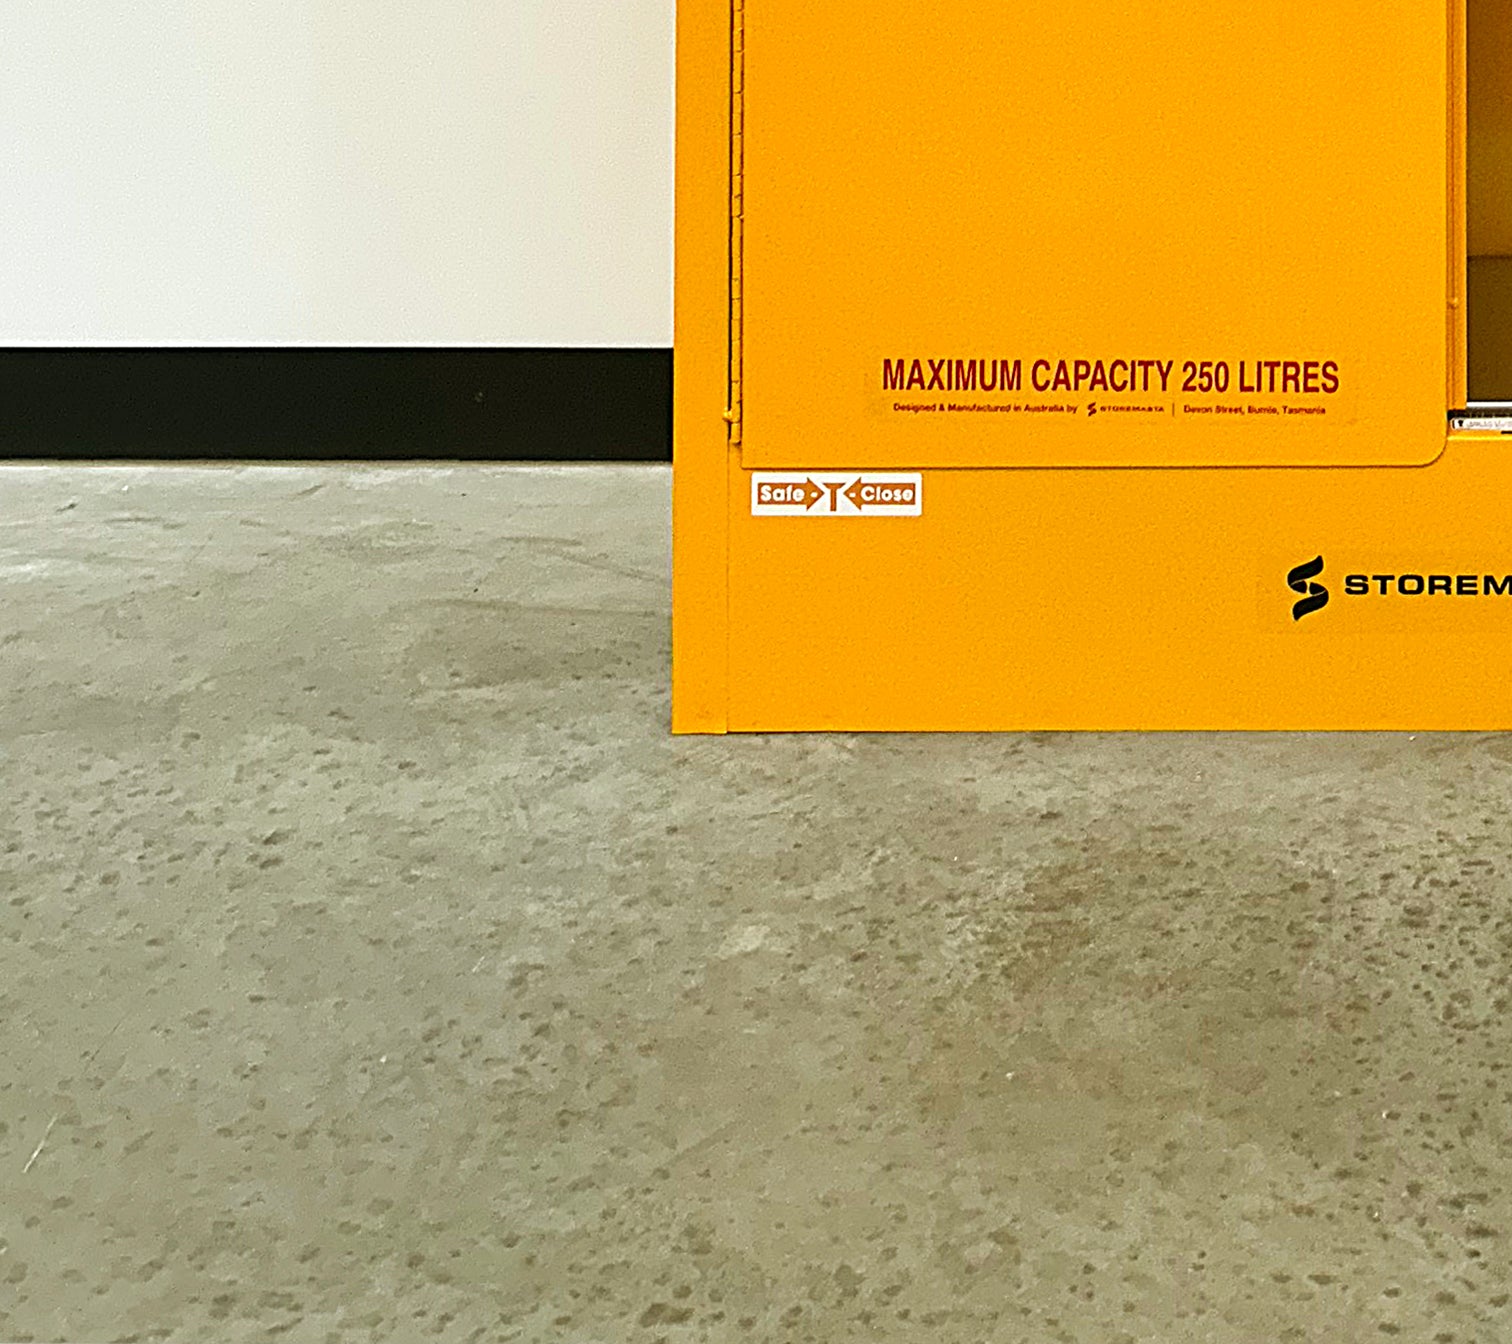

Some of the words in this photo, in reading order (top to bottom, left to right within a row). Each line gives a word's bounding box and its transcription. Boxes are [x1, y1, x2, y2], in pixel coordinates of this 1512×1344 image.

[883, 359, 1021, 391] MAXIMUM
[1032, 359, 1173, 392] CAPACITY
[1182, 361, 1229, 392] 250
[1240, 361, 1338, 393] LITRES
[894, 403, 936, 413] Designed
[948, 404, 1011, 412] Manufactured
[1014, 404, 1021, 412] in
[1067, 405, 1078, 413] by
[1283, 406, 1326, 414] Tasmania
